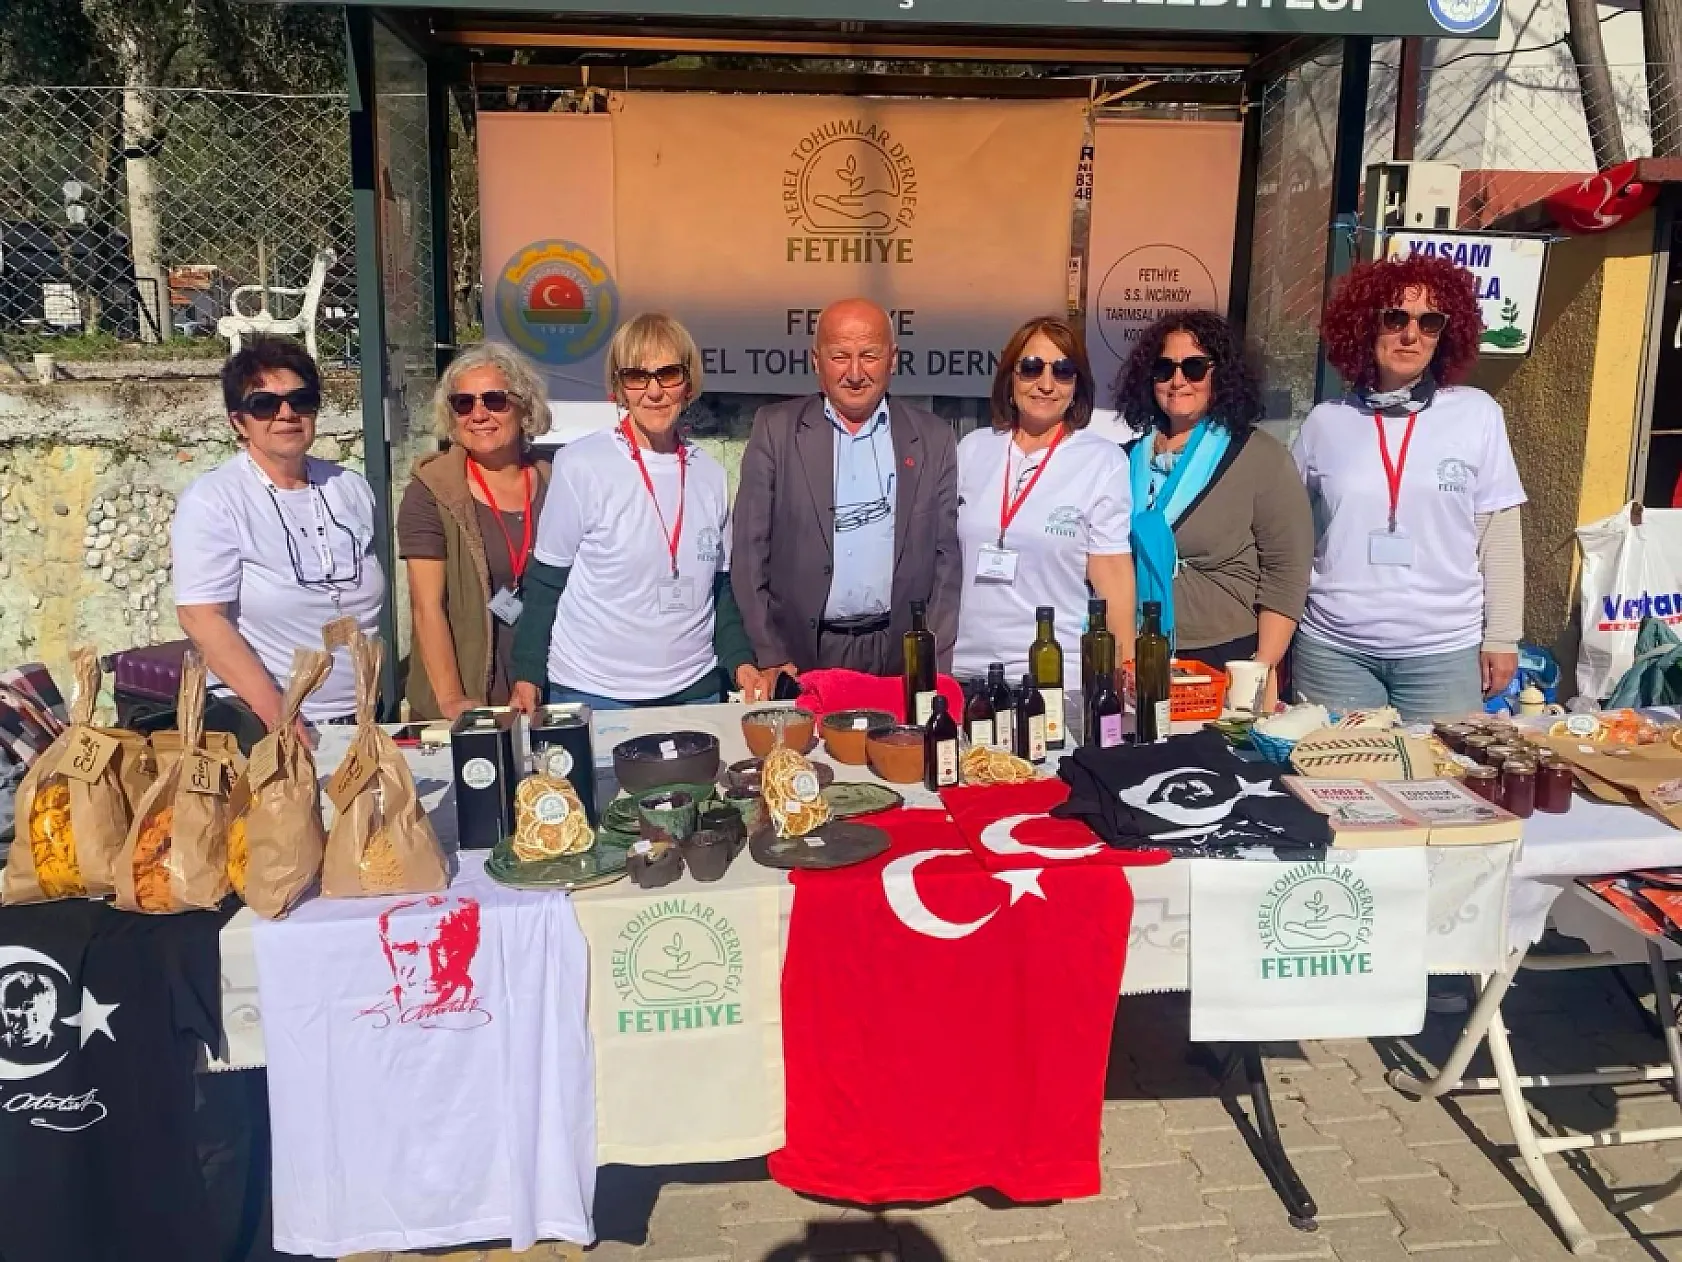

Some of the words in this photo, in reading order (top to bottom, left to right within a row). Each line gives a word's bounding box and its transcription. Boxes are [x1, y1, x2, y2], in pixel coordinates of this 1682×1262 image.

[791, 119, 891, 162] TOHUMLAR
[783, 168, 803, 227] YEREL
[785, 231, 915, 265] FETHİYE
[1138, 265, 1180, 282] FETHİYE
[1266, 860, 1354, 898] TOHUMLAR
[618, 898, 715, 941] TOHUMLAR
[1258, 902, 1277, 950] YEREL
[611, 946, 634, 1002] YEREL
[1261, 949, 1374, 980] FETHİYE
[617, 1000, 744, 1033] FETHİYE
